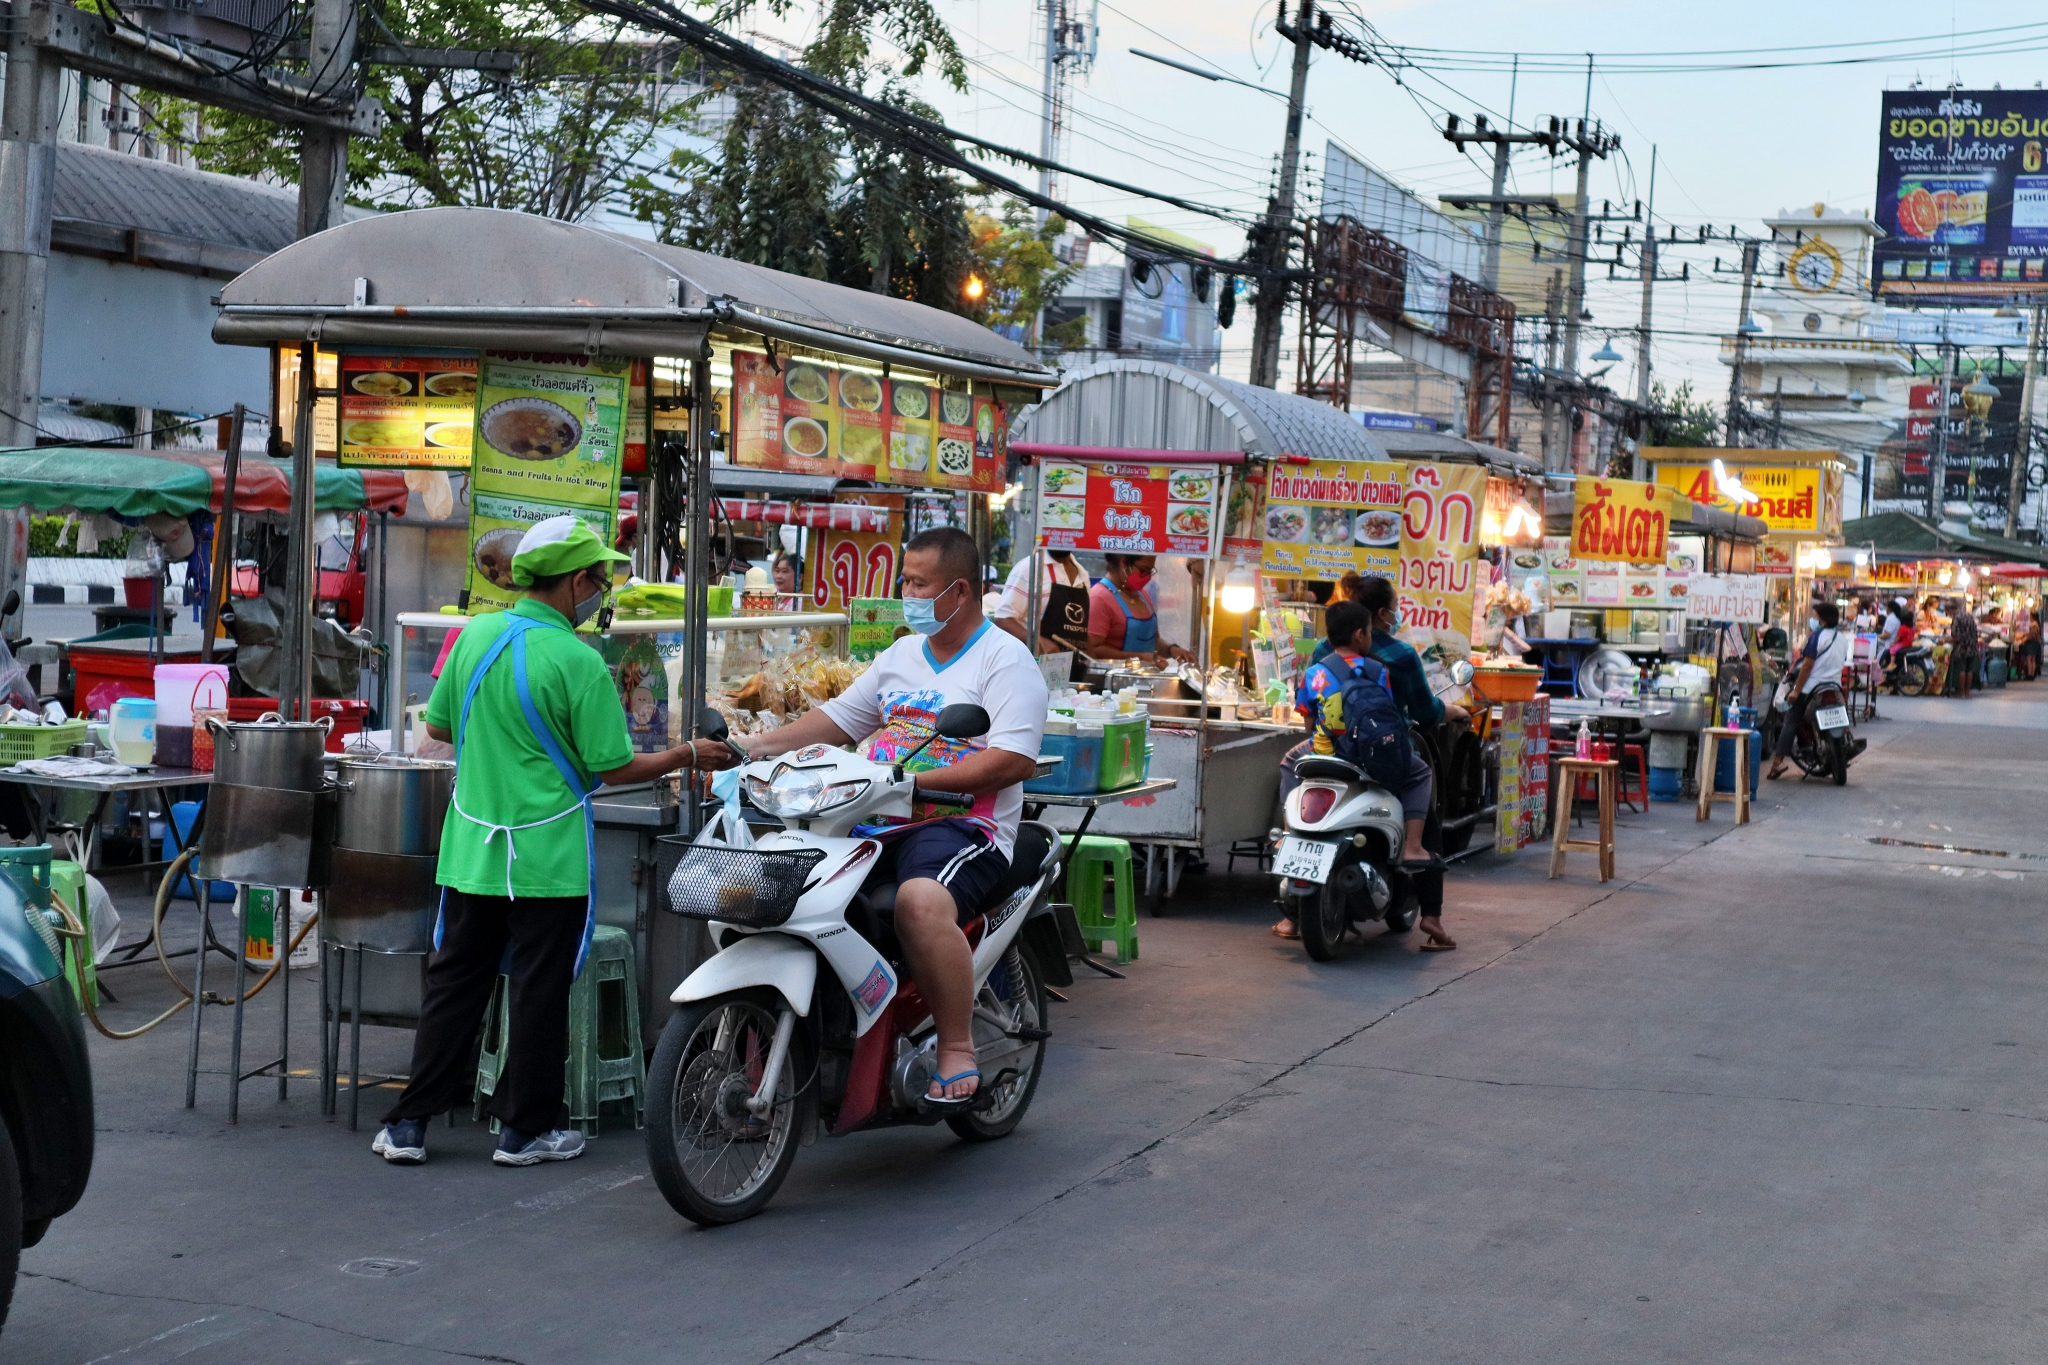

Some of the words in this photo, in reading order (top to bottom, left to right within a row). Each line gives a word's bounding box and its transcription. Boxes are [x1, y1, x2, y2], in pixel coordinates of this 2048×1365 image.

[507, 470, 524, 478] and
[528, 472, 552, 481] Fruits
[566, 477, 581, 485] Hot
[1110, 479, 1141, 503] โจ๊ก
[1404, 467, 1473, 544] จ๊ก
[1104, 508, 1151, 531] ข้าวต้ม
[1578, 482, 1664, 558] ส้มตำ
[1098, 531, 1154, 551] ทรงเครื่อง
[1400, 550, 1470, 592] าวต้ม
[926, 746, 959, 765] 2013
[1281, 862, 1319, 879] 5470
[816, 926, 848, 940] HONDA
